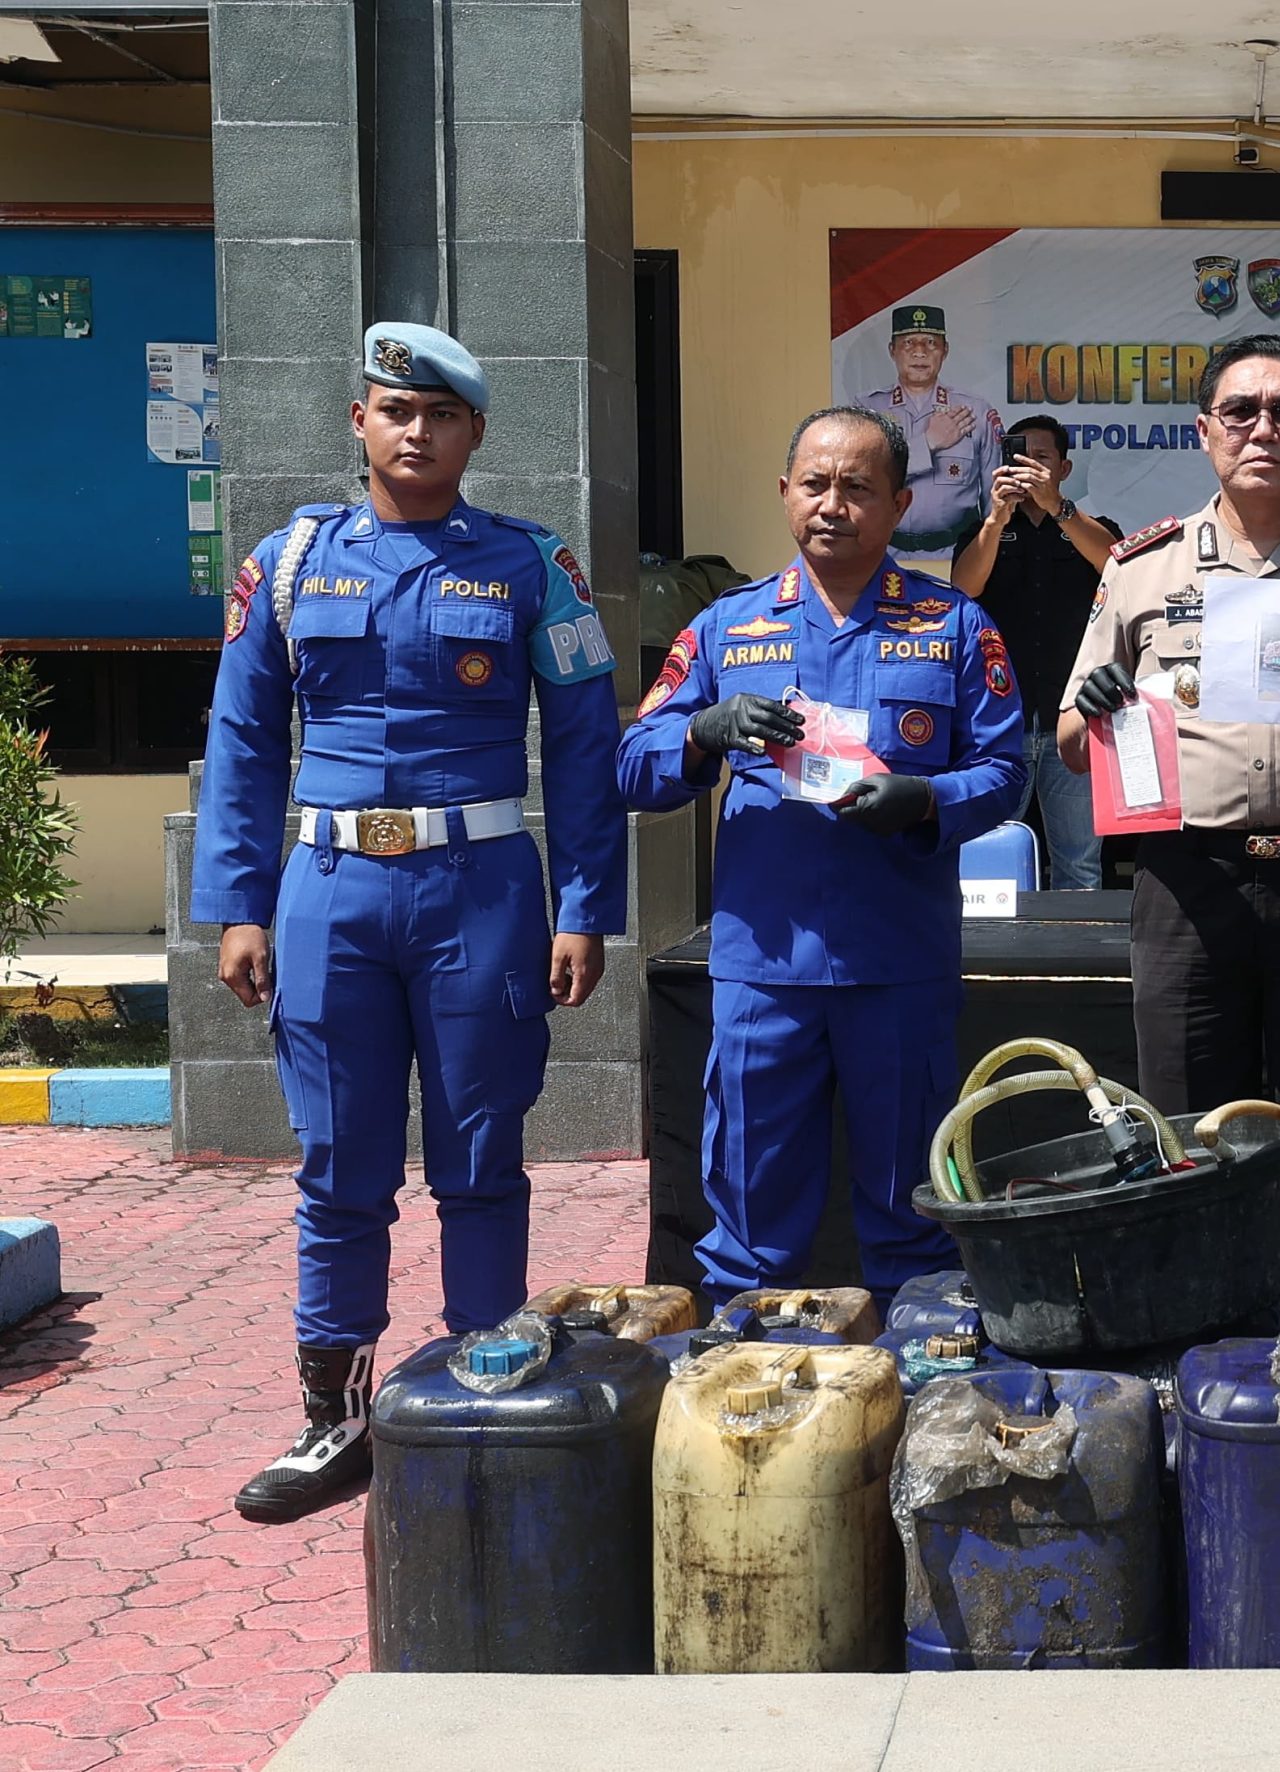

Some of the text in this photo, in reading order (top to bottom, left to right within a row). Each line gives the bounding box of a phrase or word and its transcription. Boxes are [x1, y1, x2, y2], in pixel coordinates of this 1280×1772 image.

[302, 576, 367, 597] HILMY
[440, 580, 510, 600] POLRI
[1185, 609, 1204, 617] ABAS
[547, 613, 616, 675] PR
[880, 641, 951, 661] POLRI
[722, 642, 794, 668] ARMAN
